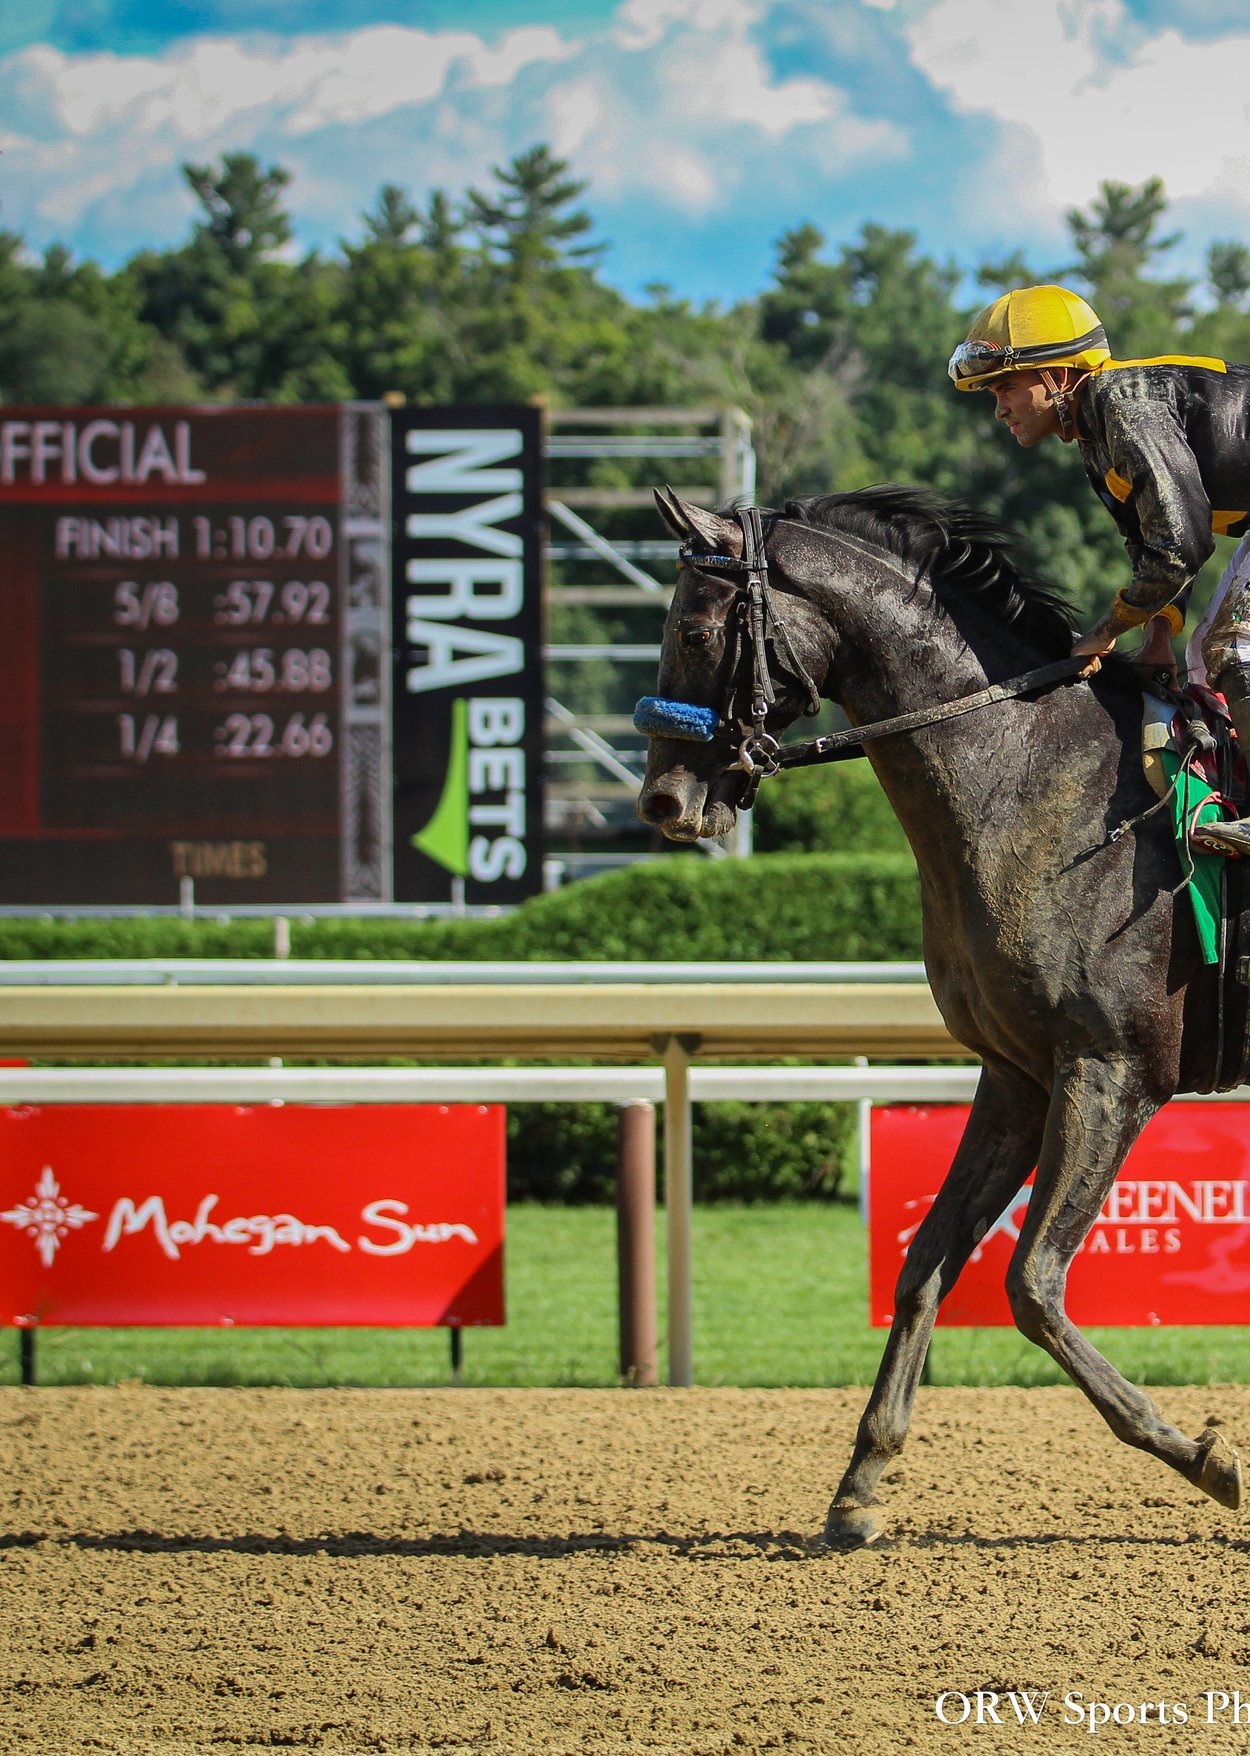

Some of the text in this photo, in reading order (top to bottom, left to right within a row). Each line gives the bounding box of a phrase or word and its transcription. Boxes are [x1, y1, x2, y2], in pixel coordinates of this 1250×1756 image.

[0, 419, 207, 485] FFICIAL
[55, 515, 333, 560] FINISH 1:10.70
[405, 429, 524, 693] NYRA
[114, 581, 331, 631] 5/8 :57.92
[117, 649, 332, 697] 1/2 :45.88
[117, 712, 333, 764] 1/4 :22.66
[467, 698, 527, 883] BETS
[169, 839, 269, 879] TIMES
[103, 1194, 478, 1260] Mohegan Sun
[1077, 1228, 1182, 1254] ALES
